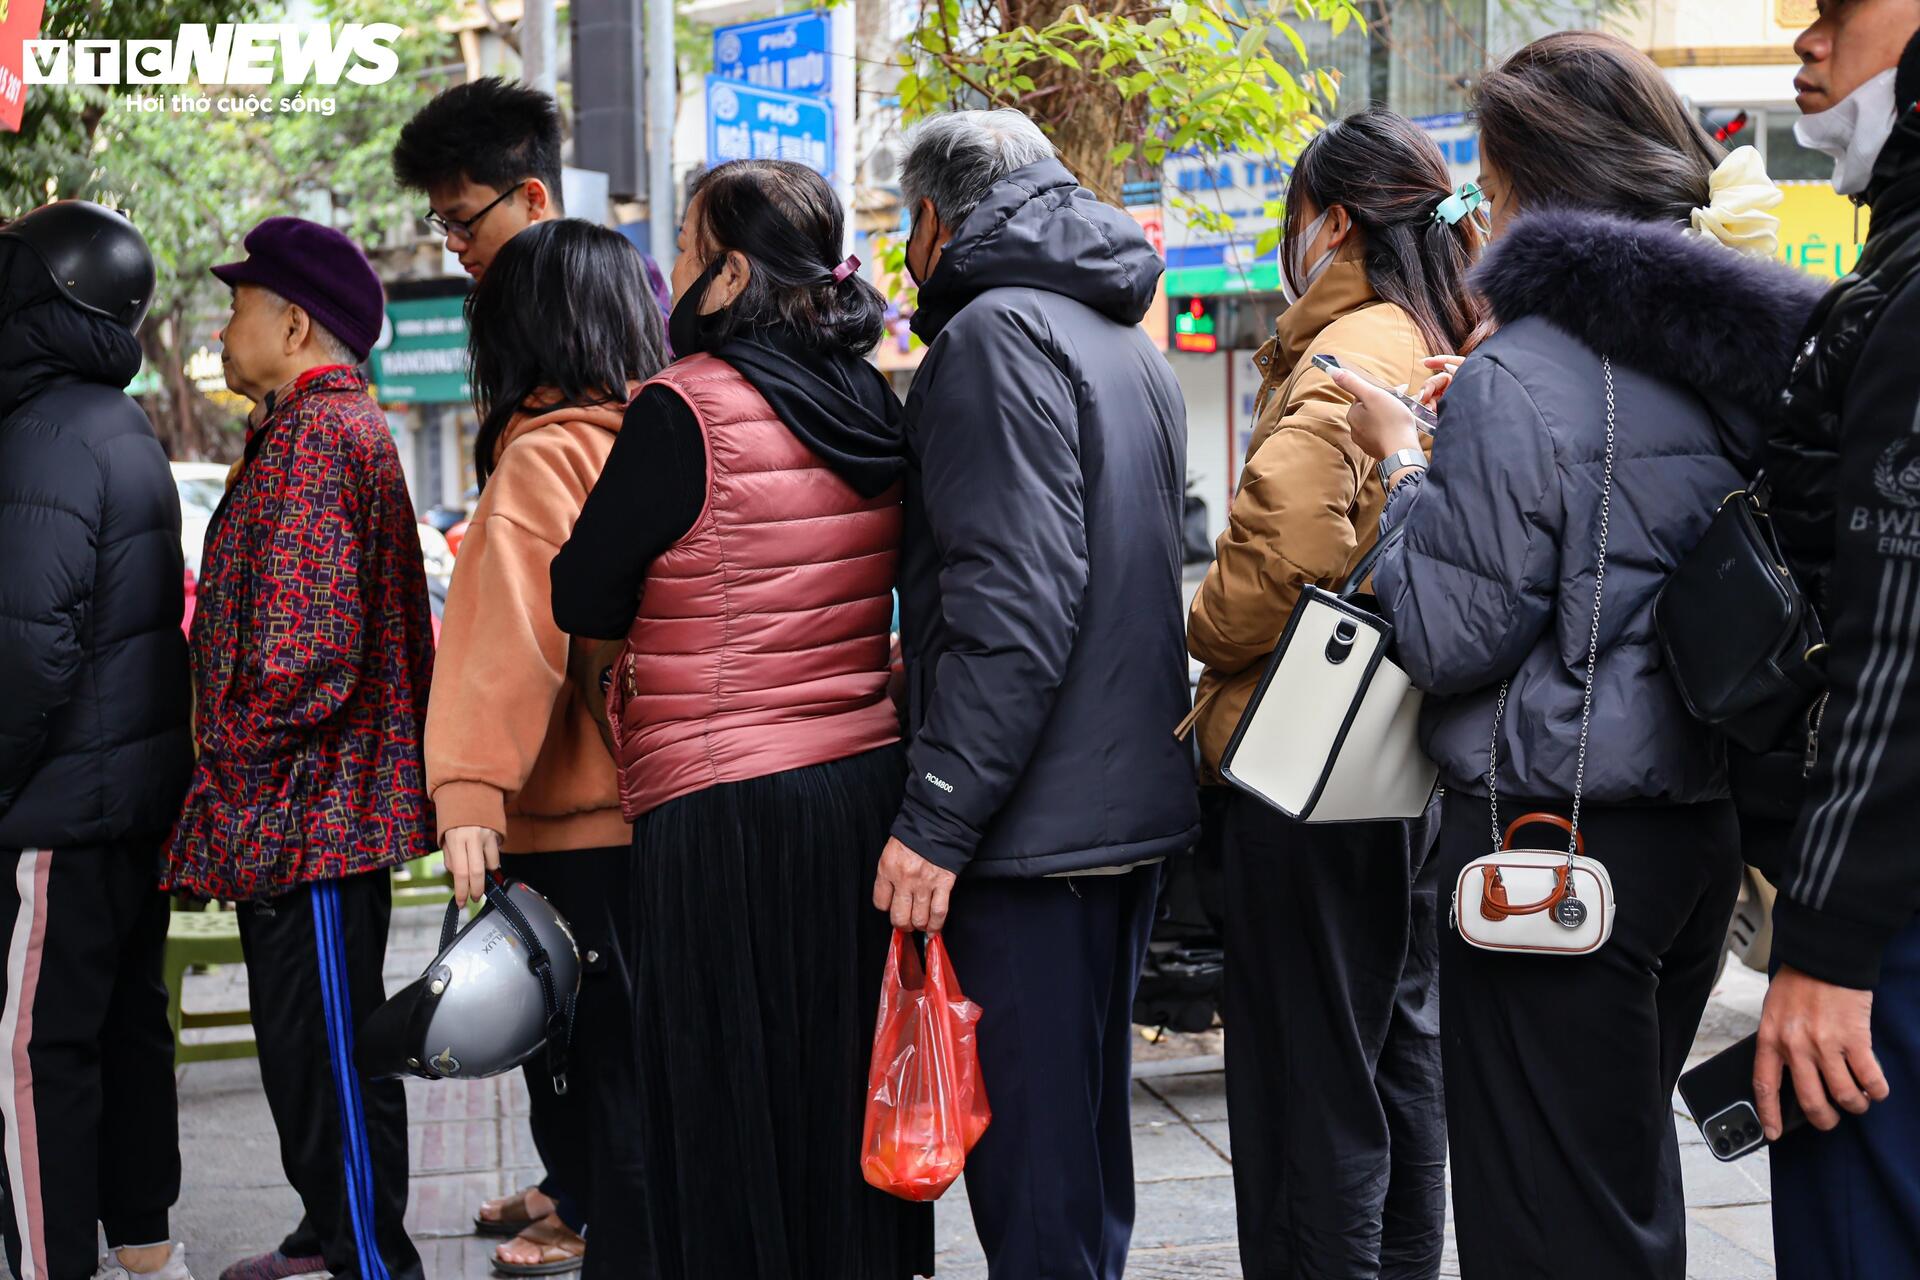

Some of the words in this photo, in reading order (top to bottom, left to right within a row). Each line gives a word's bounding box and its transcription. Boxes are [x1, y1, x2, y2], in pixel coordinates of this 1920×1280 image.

[758, 23, 798, 52] PHỐ
[757, 102, 799, 127] PHỐ
[925, 772, 953, 793] RCM800
